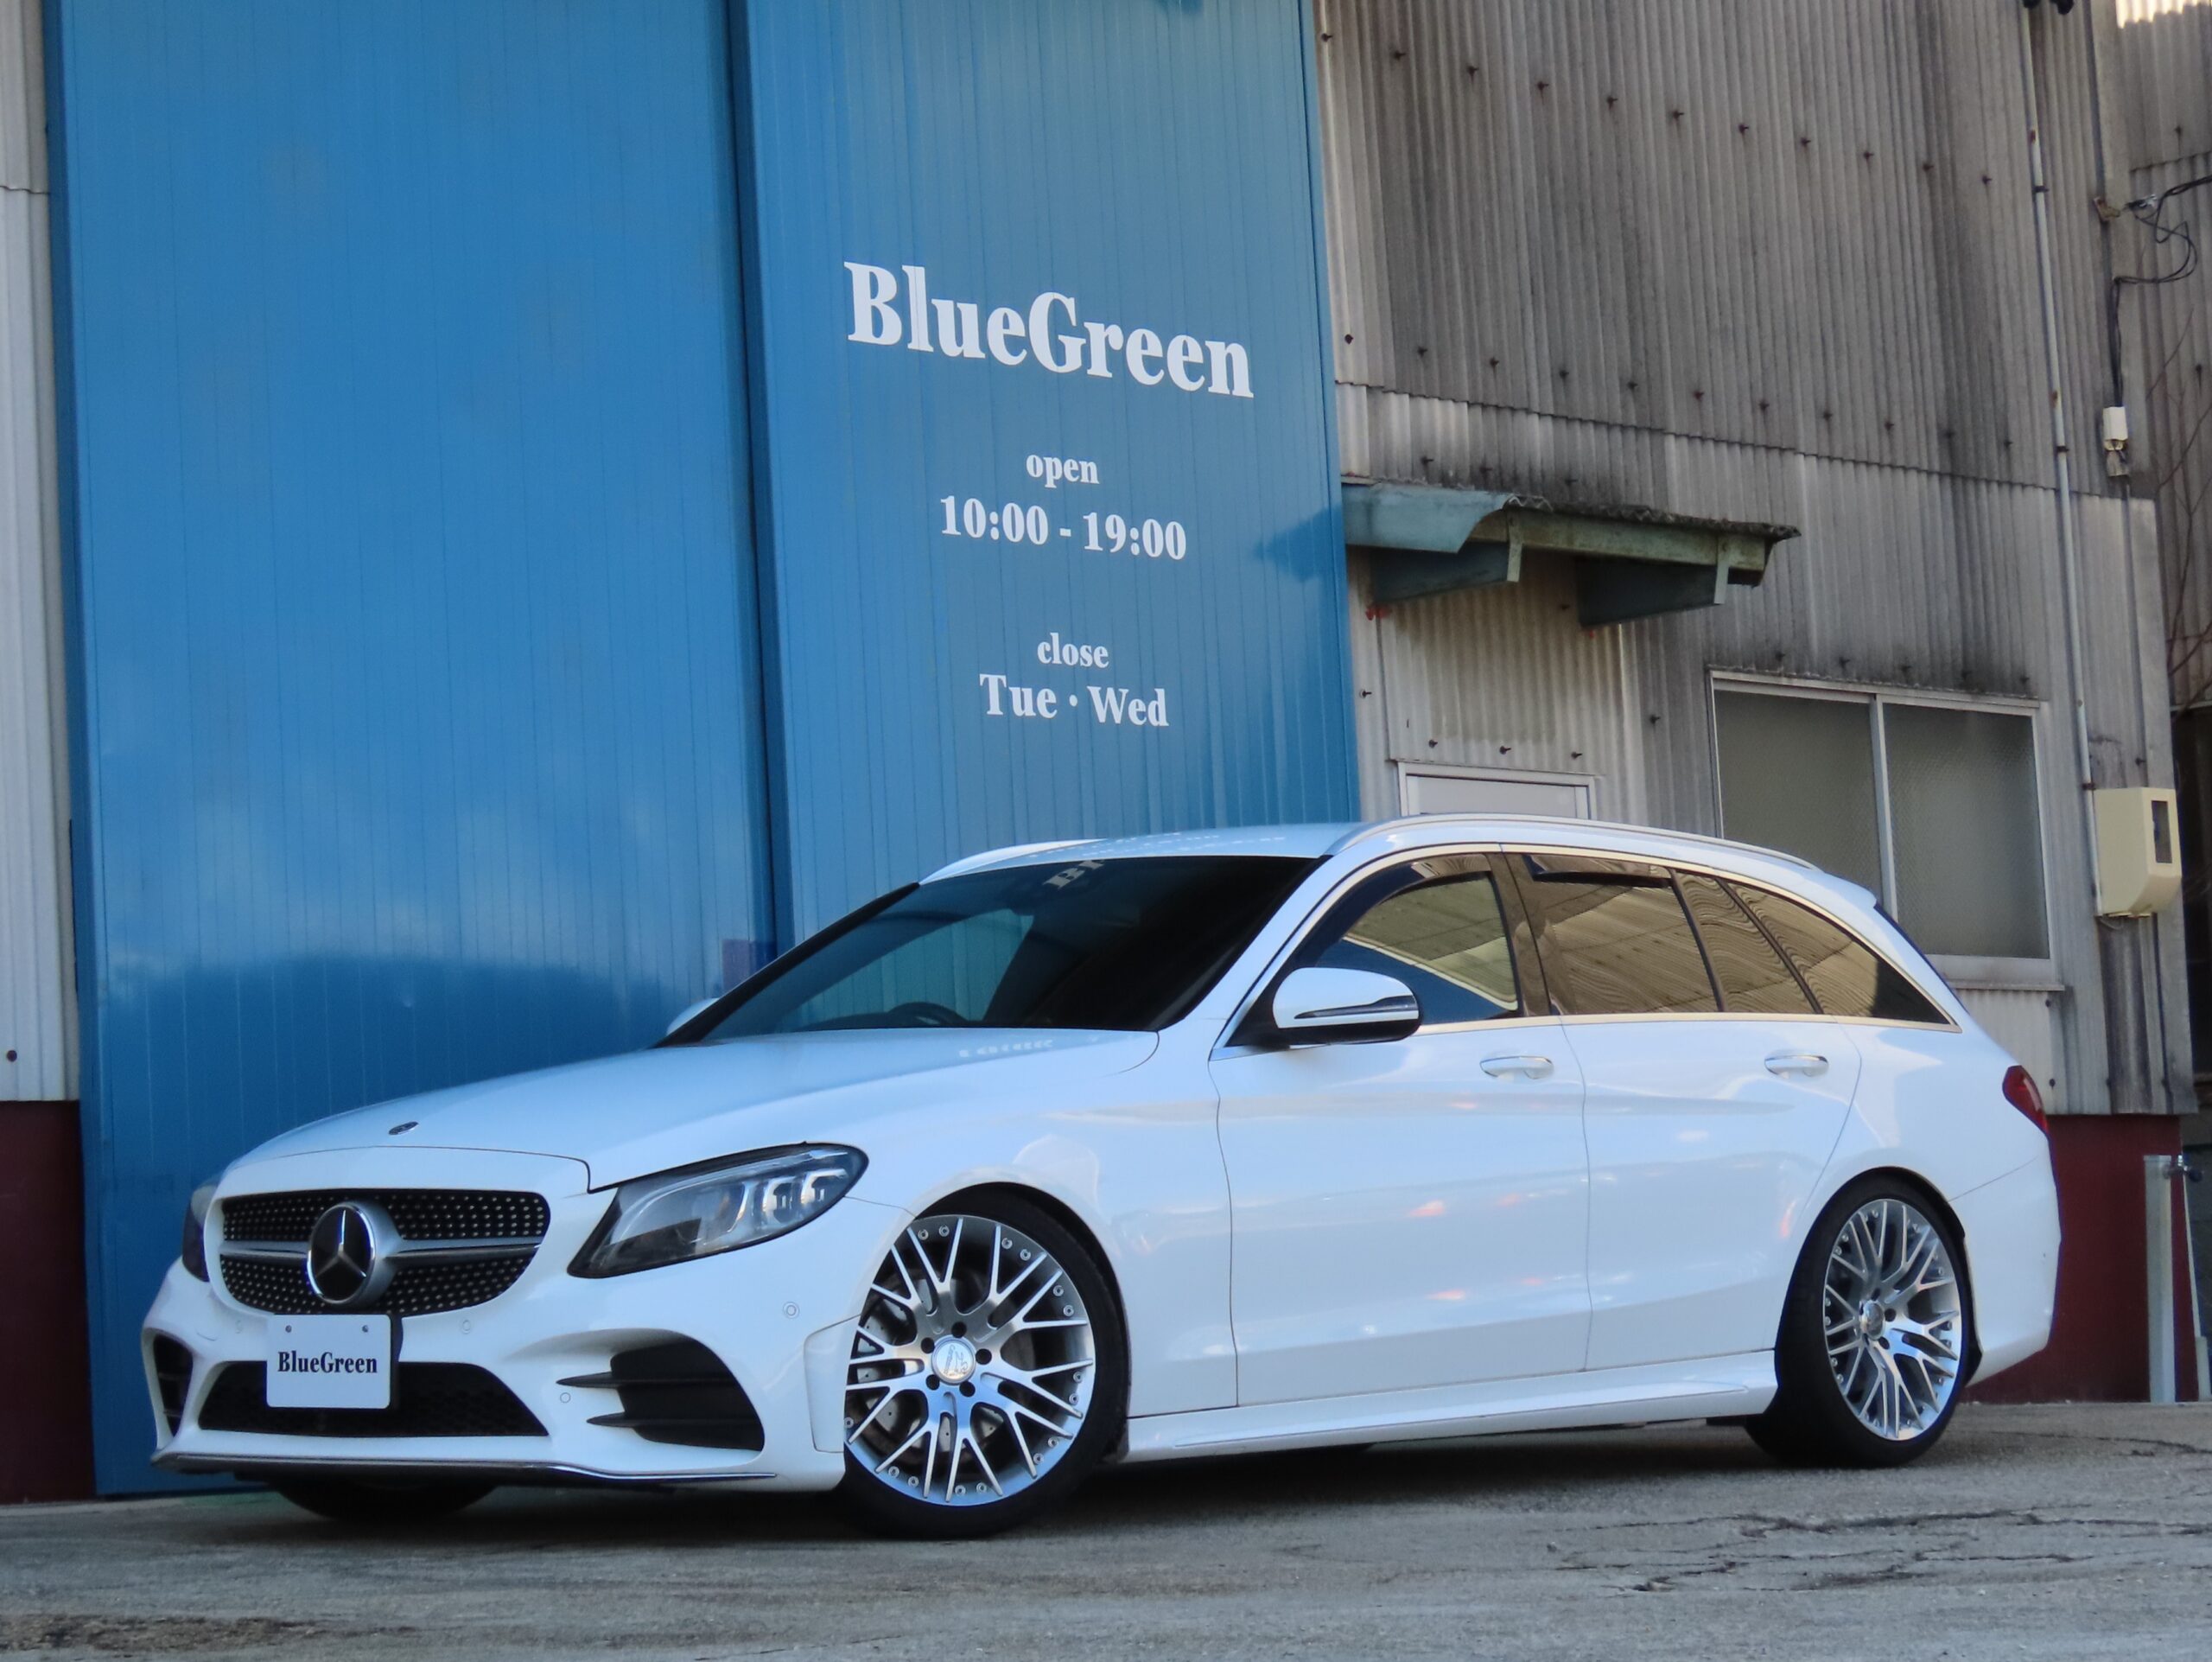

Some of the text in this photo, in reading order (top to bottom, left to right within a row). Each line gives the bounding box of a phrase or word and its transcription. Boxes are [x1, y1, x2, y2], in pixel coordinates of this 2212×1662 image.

[843, 261, 1255, 398] BlueGreen
[1026, 454, 1100, 488] open
[940, 495, 1049, 545] 10:00
[1083, 512, 1187, 560] 19:00
[1037, 632, 1109, 669] close
[979, 673, 1058, 719] Tue
[1087, 685, 1169, 727] Wed
[277, 1350, 378, 1374] BlueGreen
